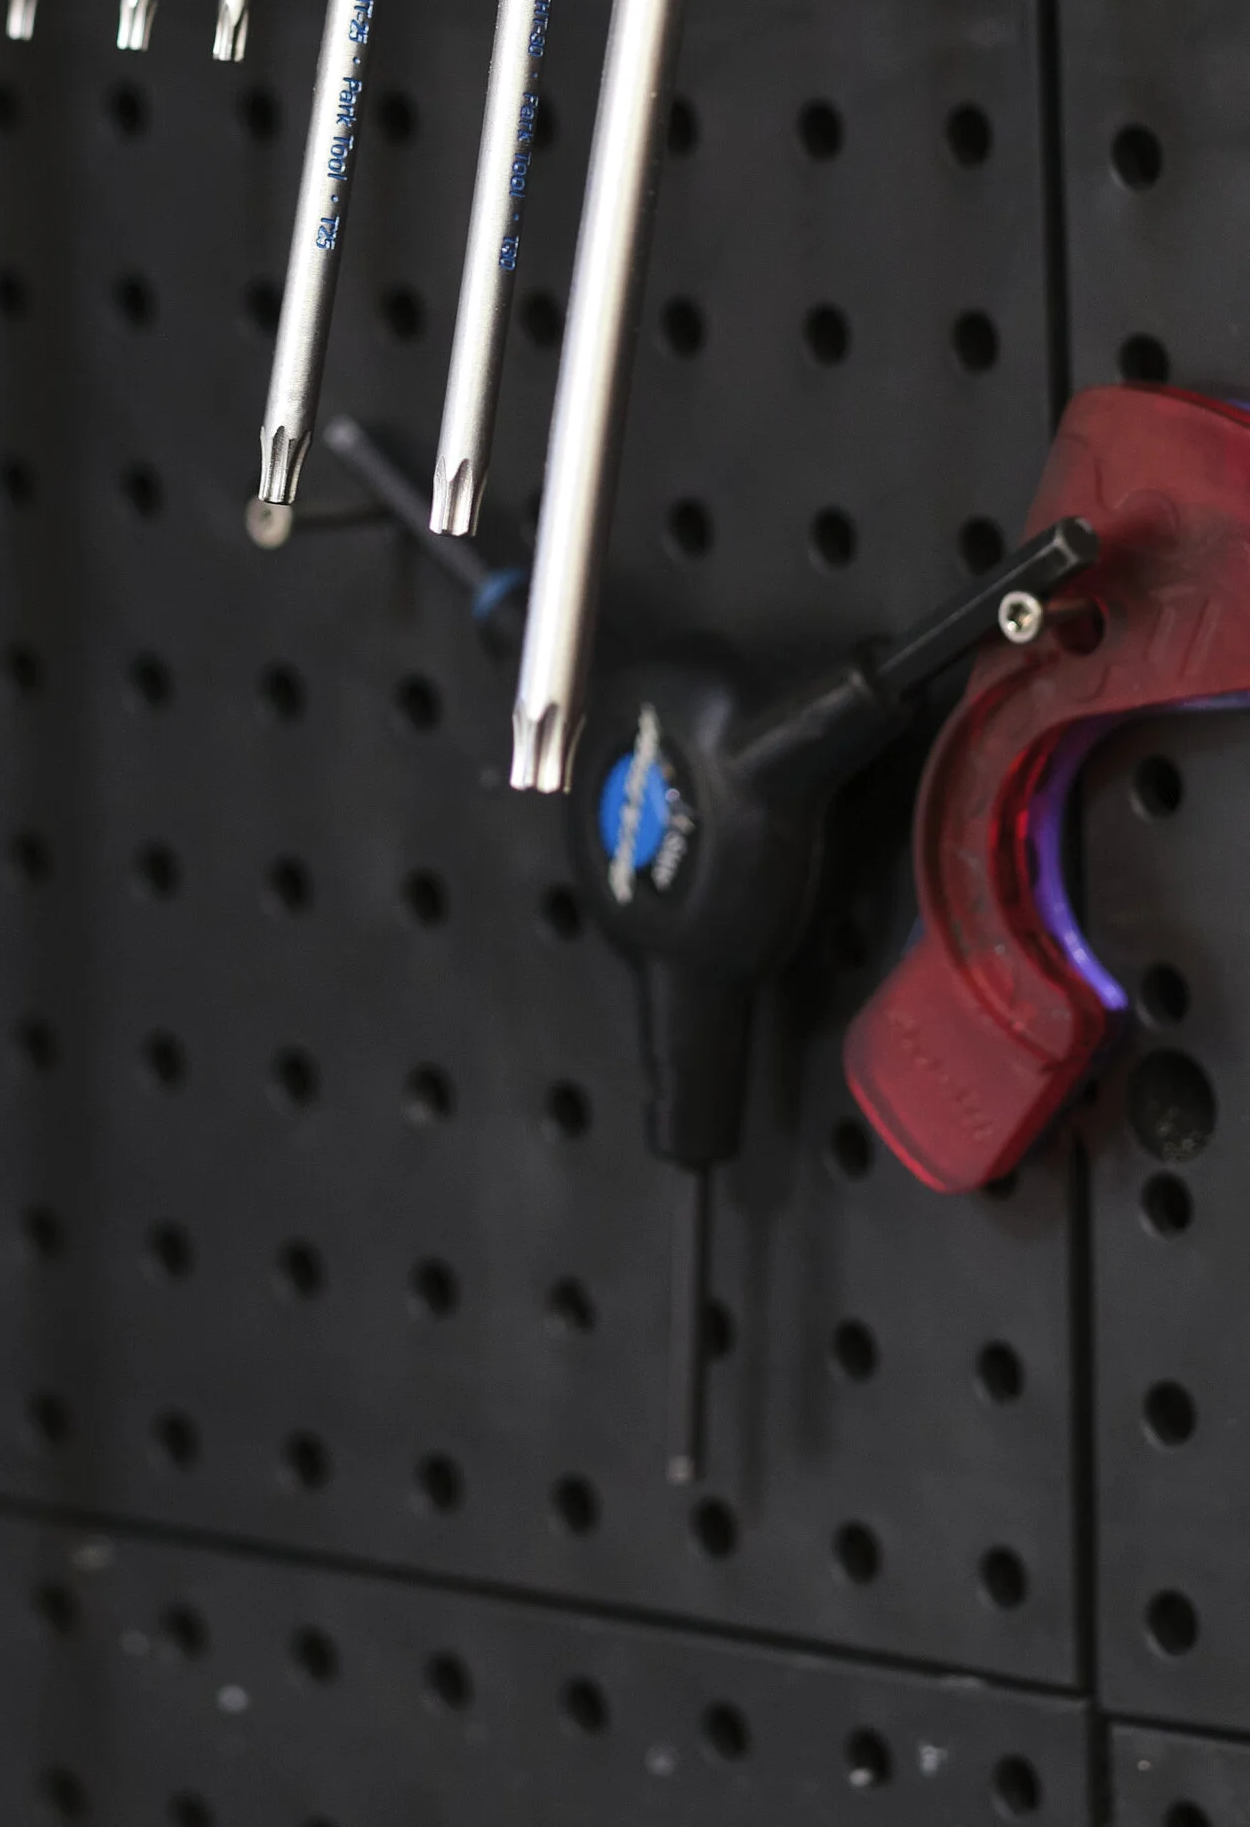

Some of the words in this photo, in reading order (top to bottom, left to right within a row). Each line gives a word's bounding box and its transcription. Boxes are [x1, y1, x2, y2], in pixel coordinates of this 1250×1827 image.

[336, 77, 363, 127] Park
[517, 92, 538, 142] Park
[328, 135, 354, 180] Tool
[509, 152, 530, 197] Tool
[316, 216, 340, 250] T25
[499, 236, 520, 271] T30
